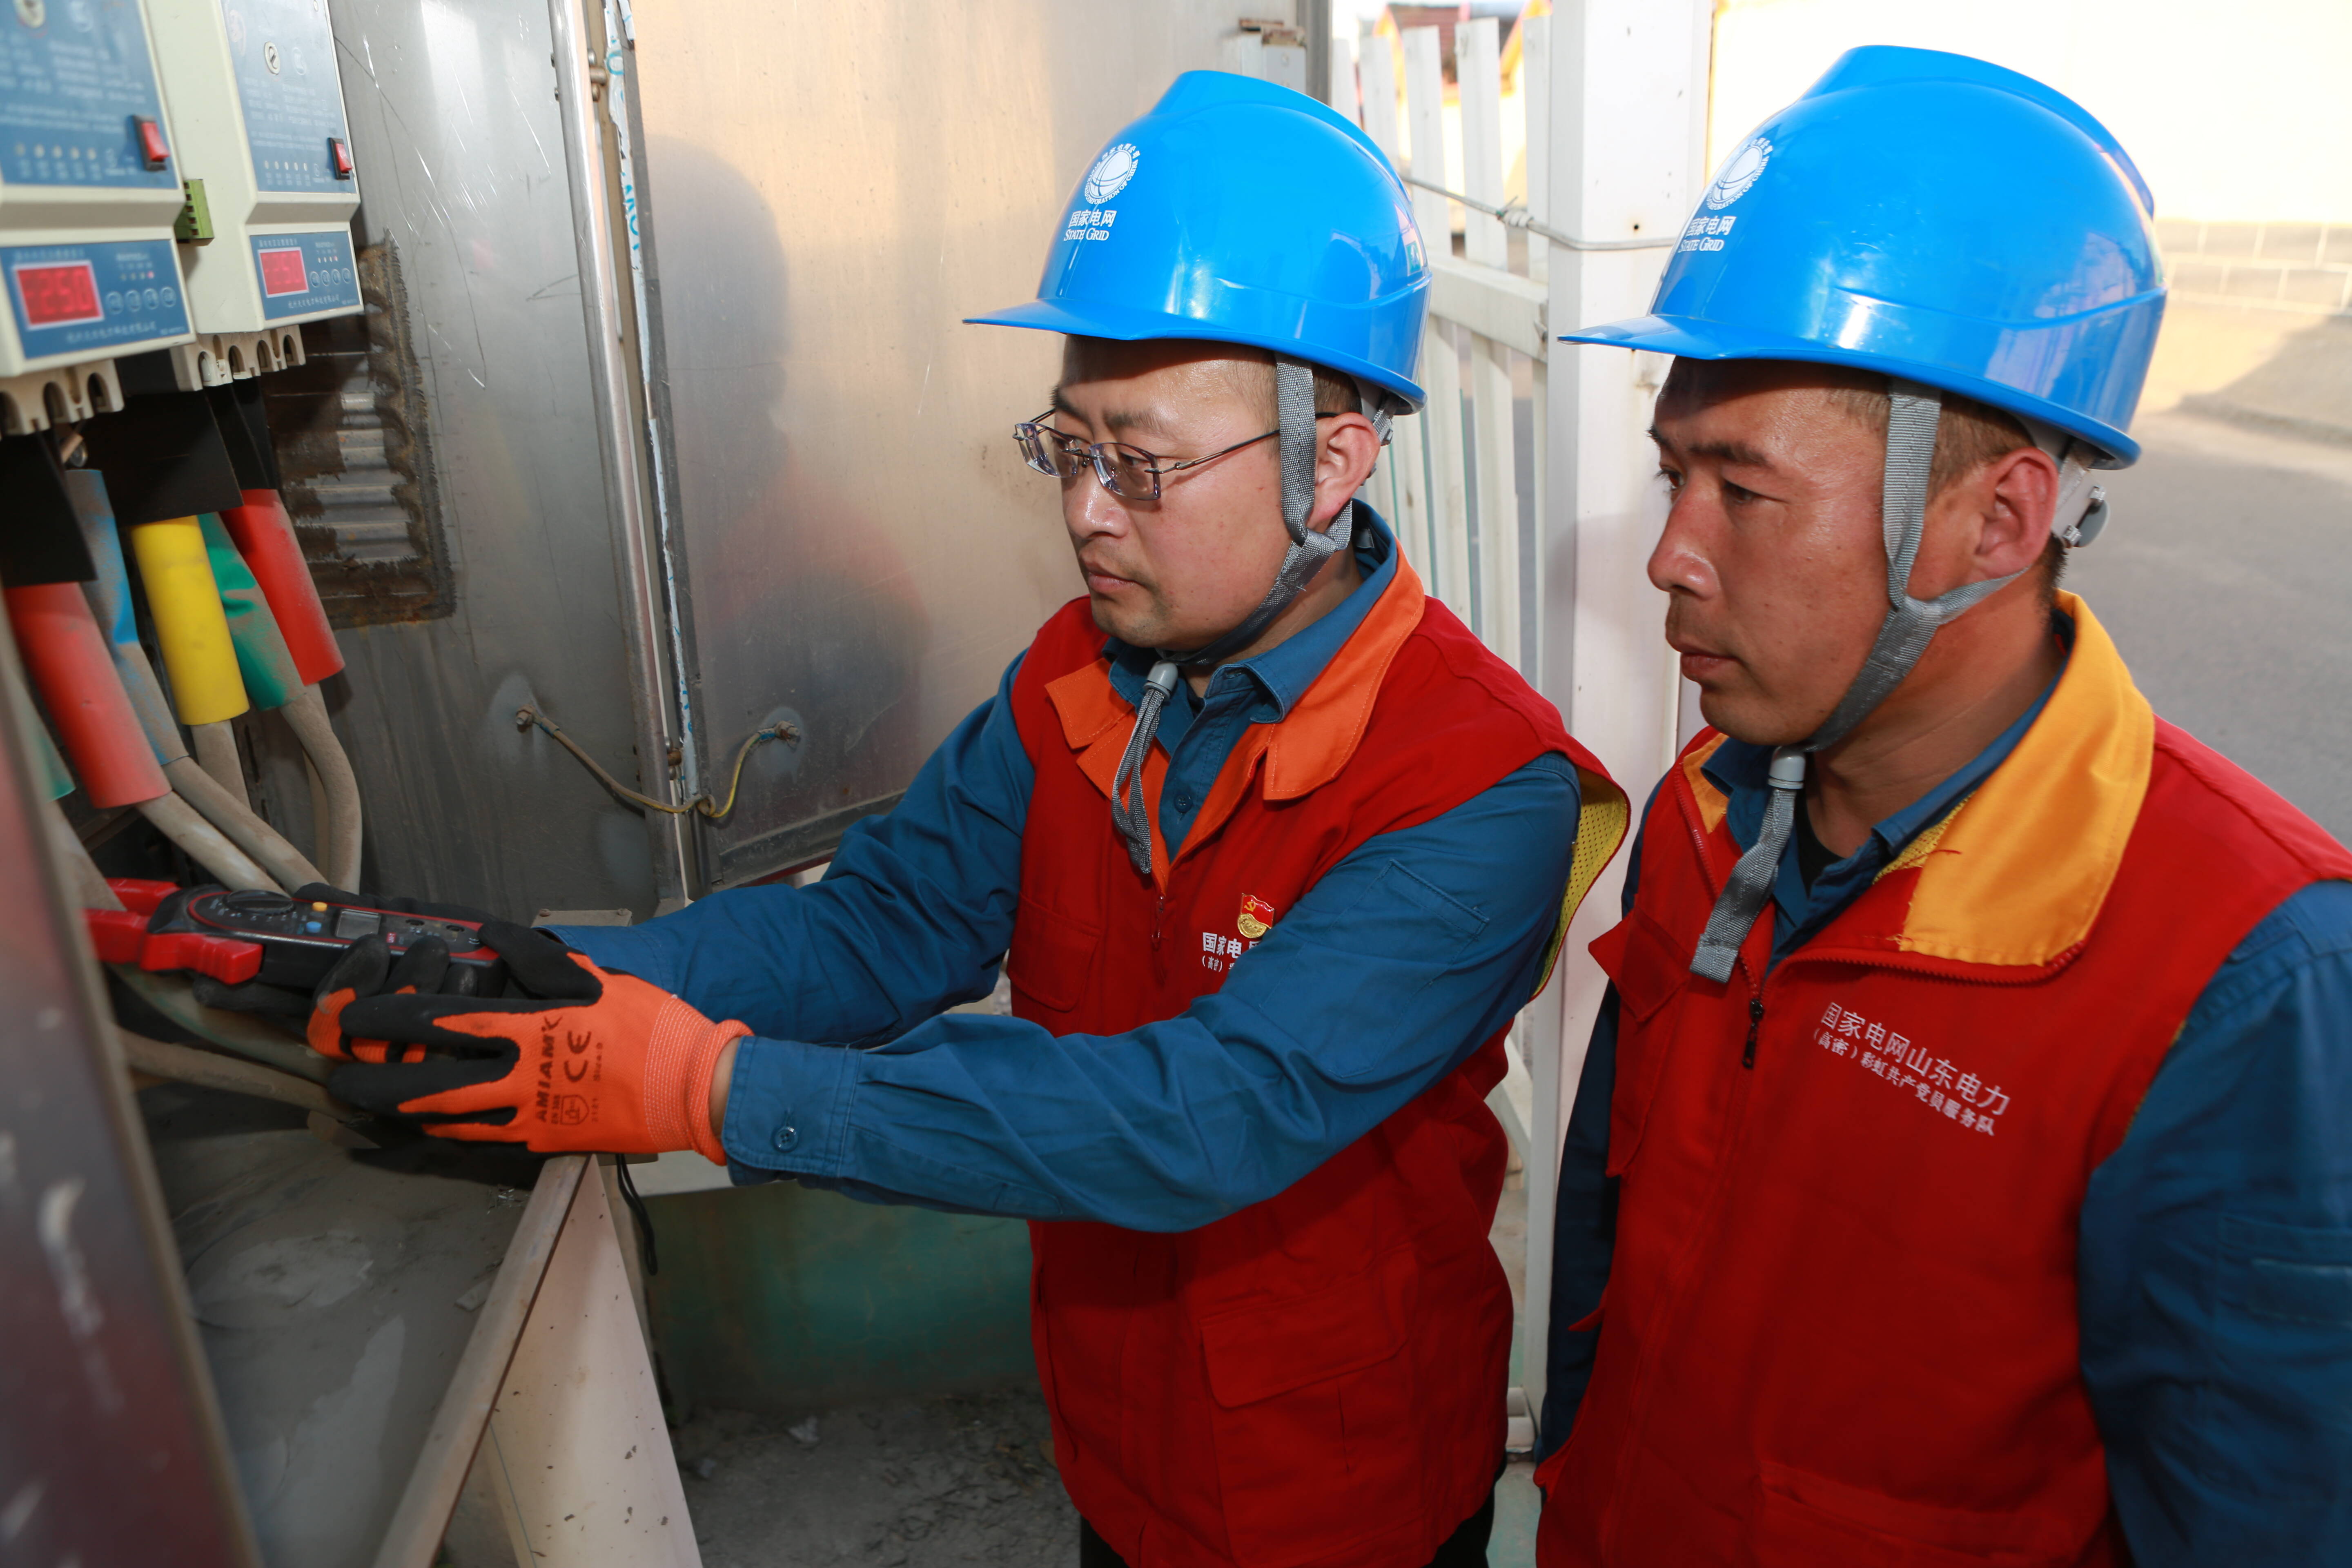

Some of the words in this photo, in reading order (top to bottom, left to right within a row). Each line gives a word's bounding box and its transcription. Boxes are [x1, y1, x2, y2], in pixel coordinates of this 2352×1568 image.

[1119, 180, 1128, 190] OF
[1126, 159, 1139, 181] CHINA
[1068, 209, 1117, 228] 国家电网
[1685, 216, 1737, 238] 国家电网
[1064, 229, 1085, 241] STATE
[1086, 227, 1109, 241] GRID
[1678, 239, 1699, 253] STATE
[1699, 237, 1724, 251] GRID
[564, 1030, 591, 1082] CE
[1821, 1002, 2010, 1116] 国家电网山东电力
[1813, 1028, 1994, 1136] （高密）彩虹共产党员服务队
